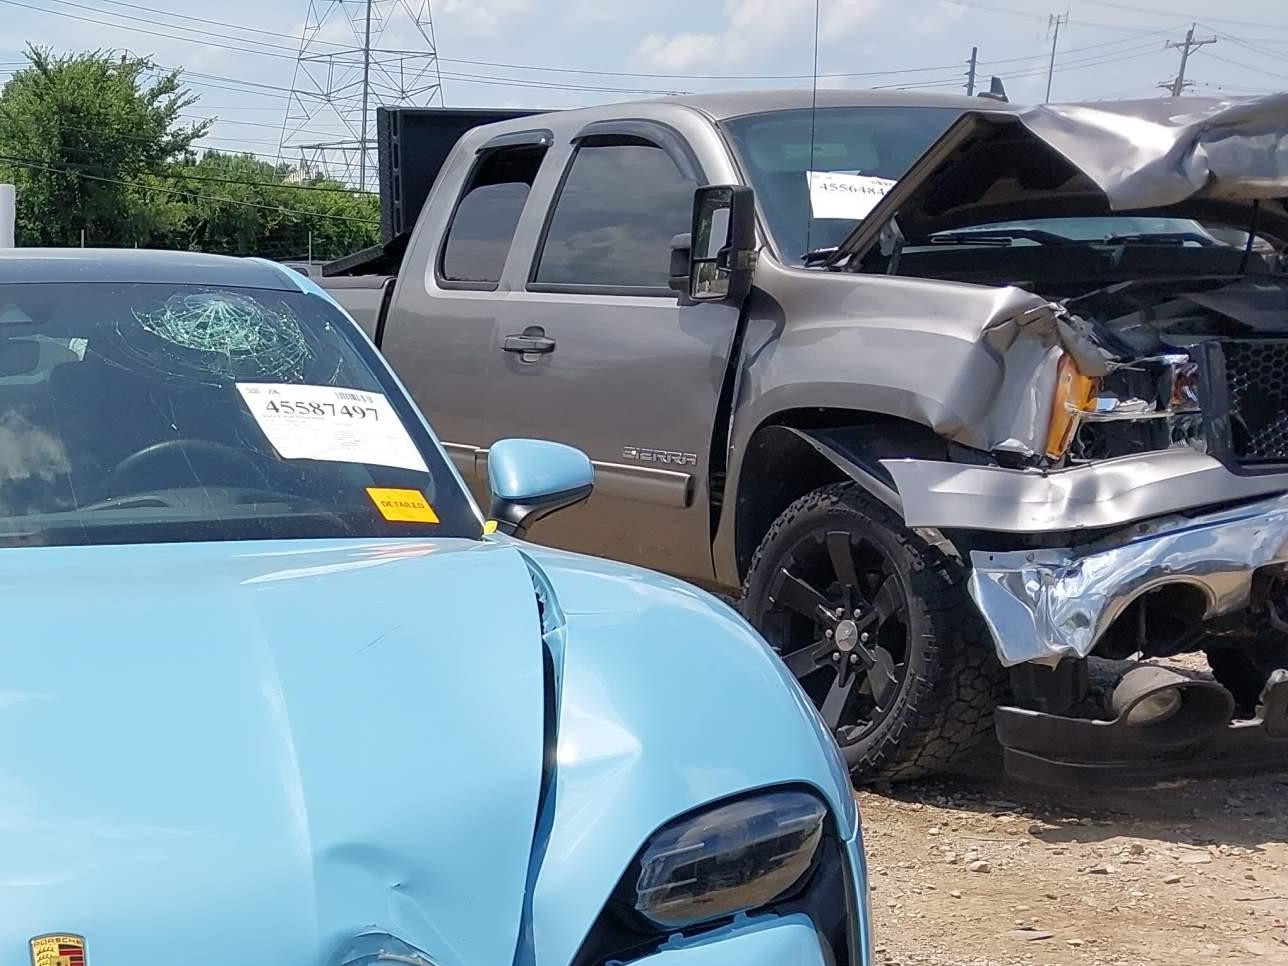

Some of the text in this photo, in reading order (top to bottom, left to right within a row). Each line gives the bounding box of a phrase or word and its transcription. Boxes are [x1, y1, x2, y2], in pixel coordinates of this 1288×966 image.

[819, 183, 888, 196] 4556484
[265, 400, 380, 422] 45587497
[622, 445, 698, 466] SIERRA
[380, 500, 425, 509] DETAILED
[33, 937, 83, 948] PORSCHE
